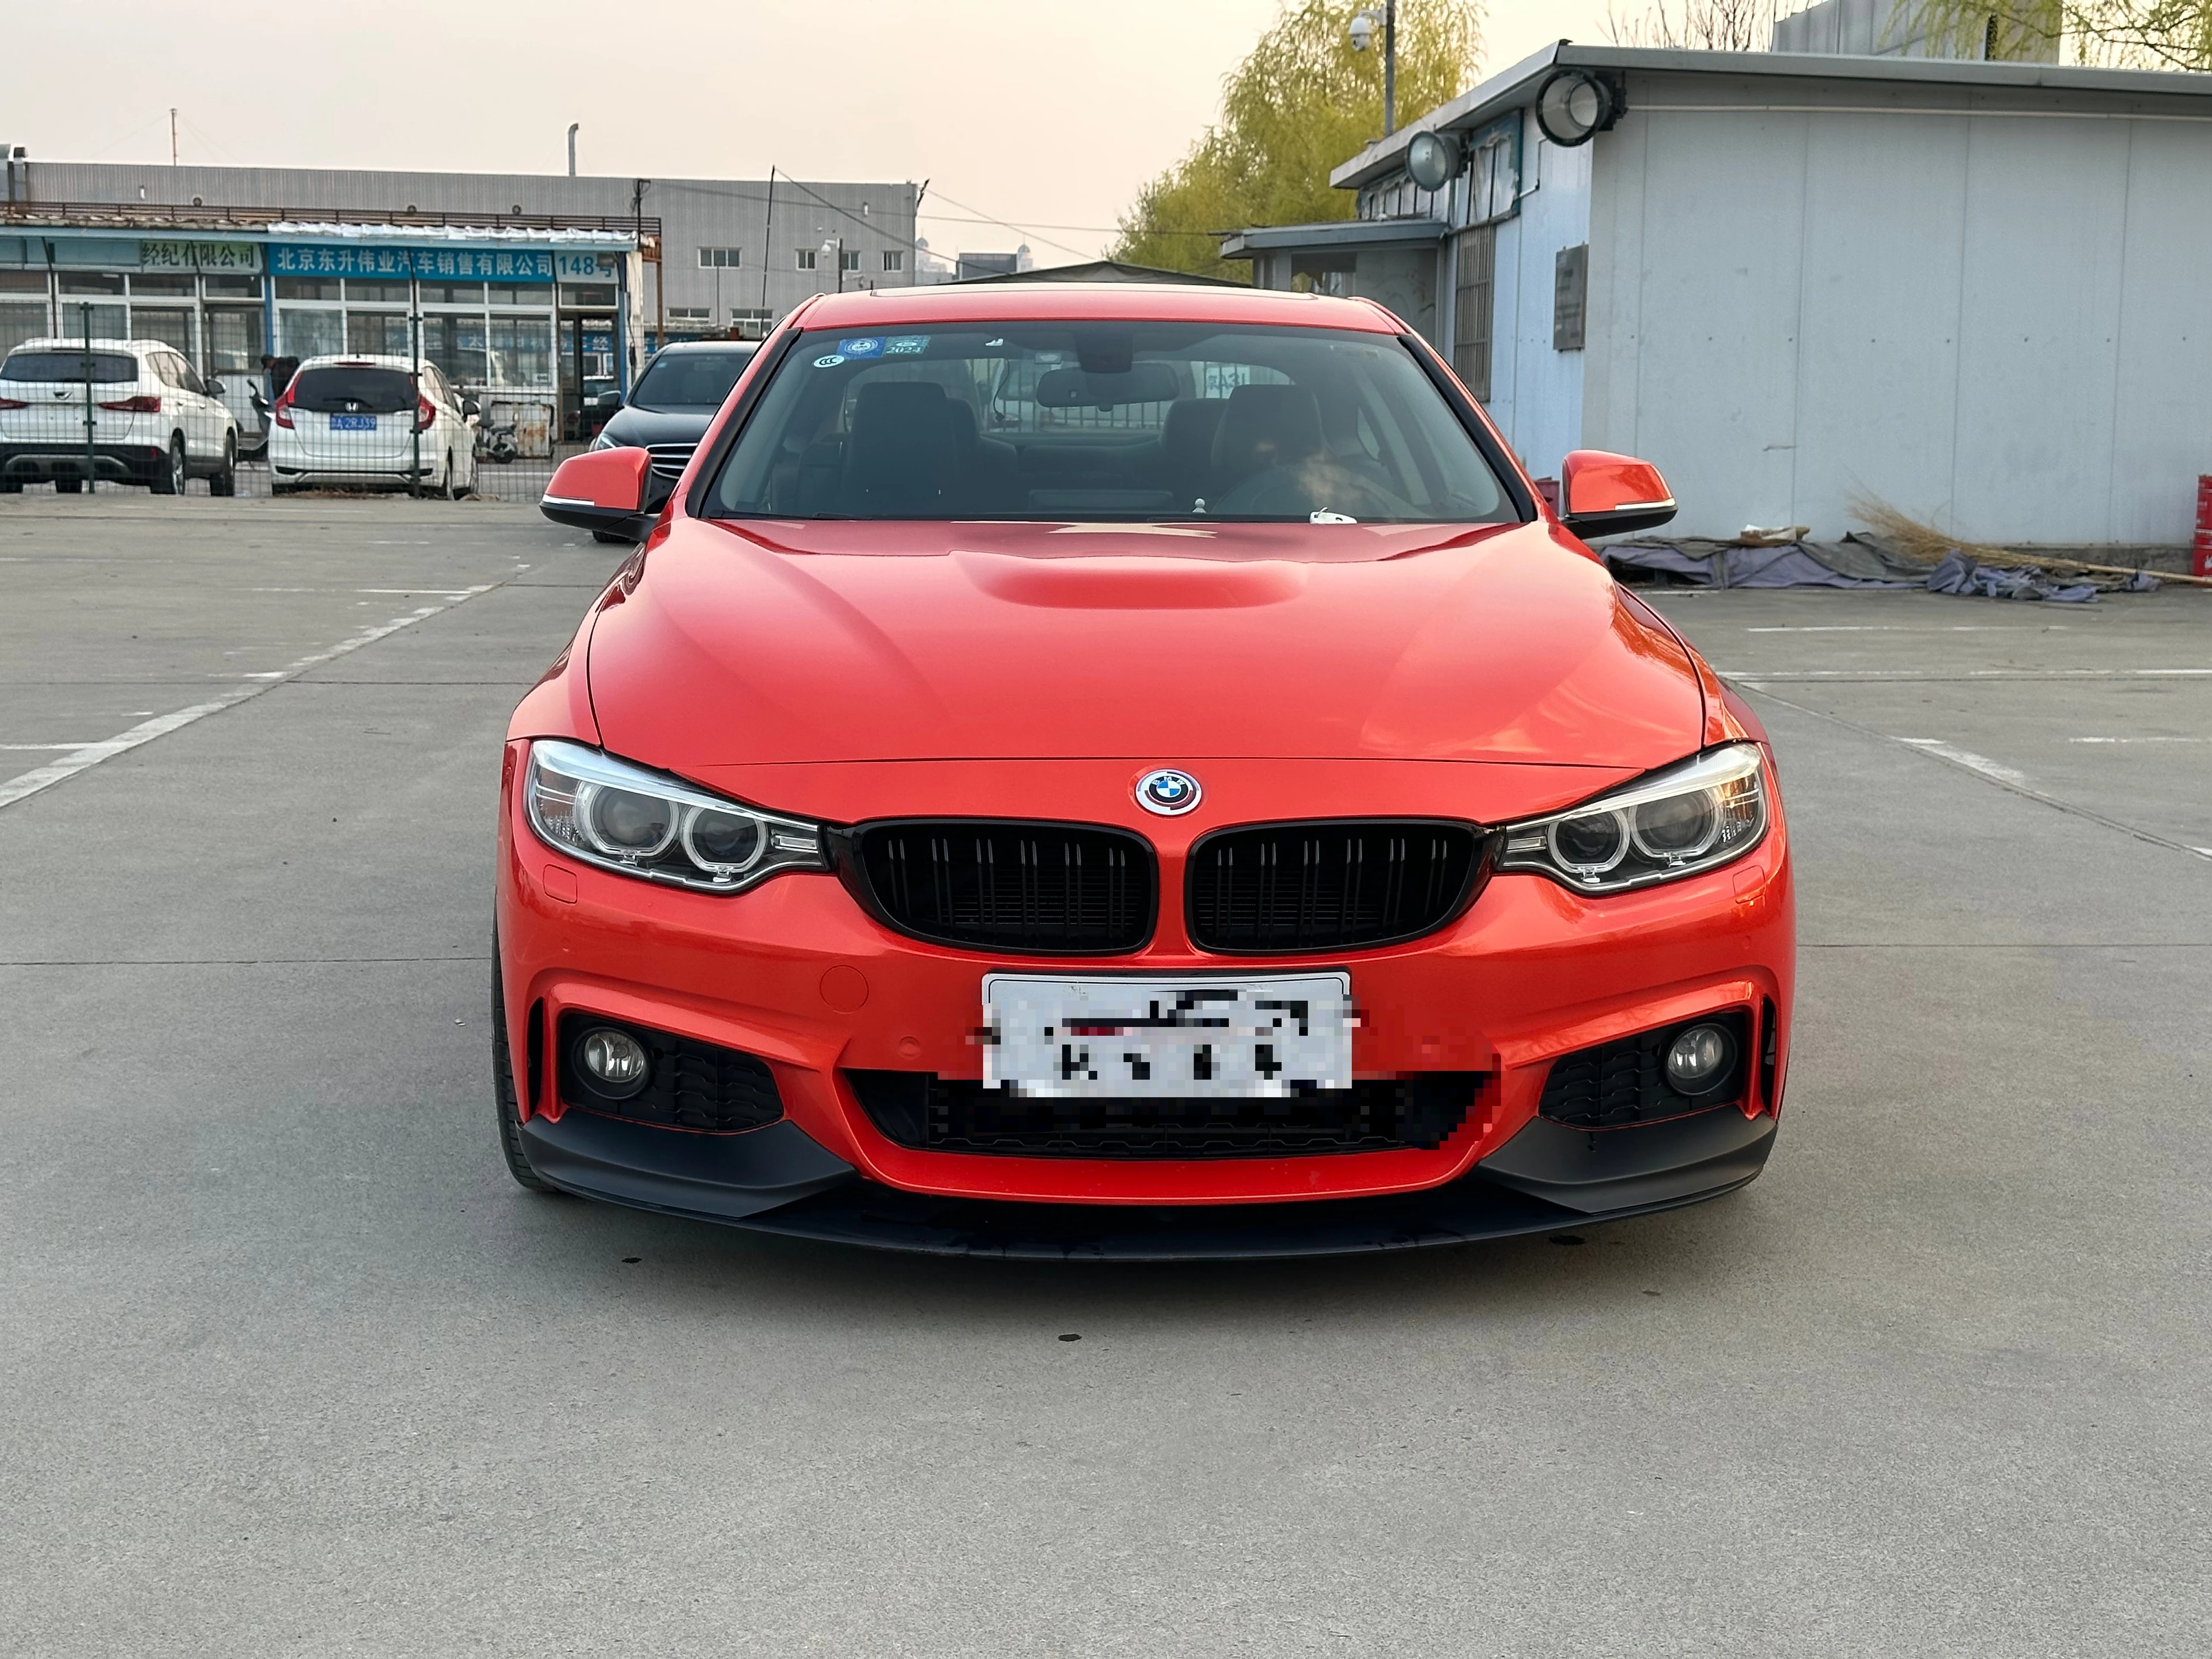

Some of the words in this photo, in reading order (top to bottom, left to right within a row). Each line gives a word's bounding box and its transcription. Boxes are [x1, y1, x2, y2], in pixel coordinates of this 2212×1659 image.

[277, 248, 553, 276] 北京东升伟业汽车销售有限公司
[1152, 776, 1185, 785] BMW
